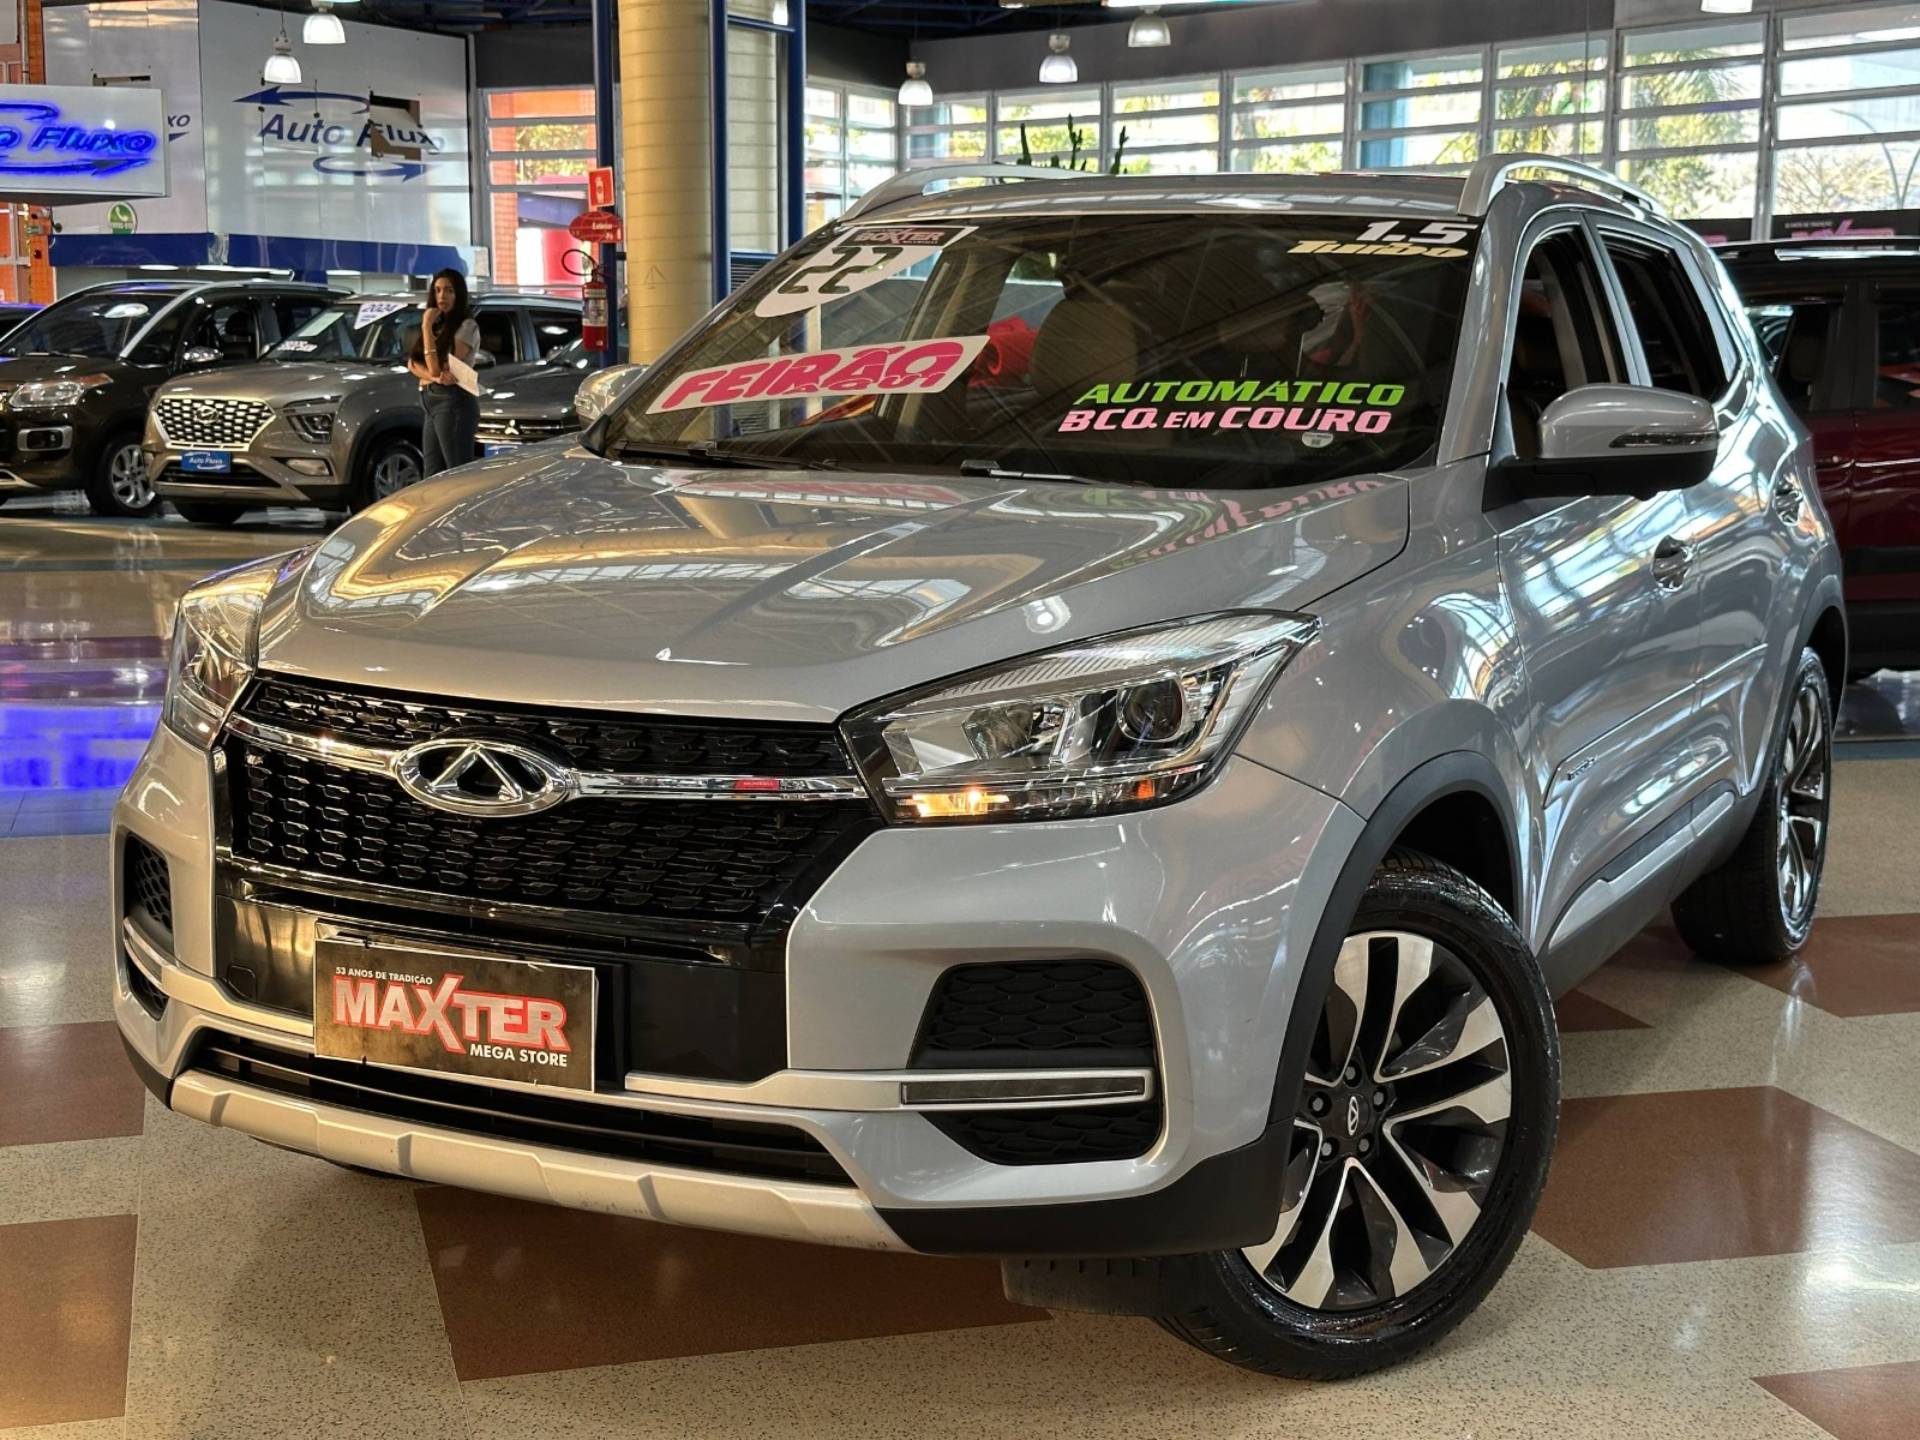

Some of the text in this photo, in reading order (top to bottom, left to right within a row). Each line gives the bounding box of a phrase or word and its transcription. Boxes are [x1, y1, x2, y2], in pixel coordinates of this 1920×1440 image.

[30, 126, 154, 152] Fluxo
[259, 113, 345, 146] Auto
[854, 228, 945, 245] BOXTER
[1356, 220, 1480, 245] 1.5
[777, 246, 904, 294] 22
[1163, 411, 1216, 428] EM
[1218, 407, 1392, 434] COURO
[348, 967, 374, 978] ANOS
[375, 971, 388, 980] DE
[332, 973, 572, 1054] MAXTER
[469, 1043, 568, 1067] MEGA STORE
